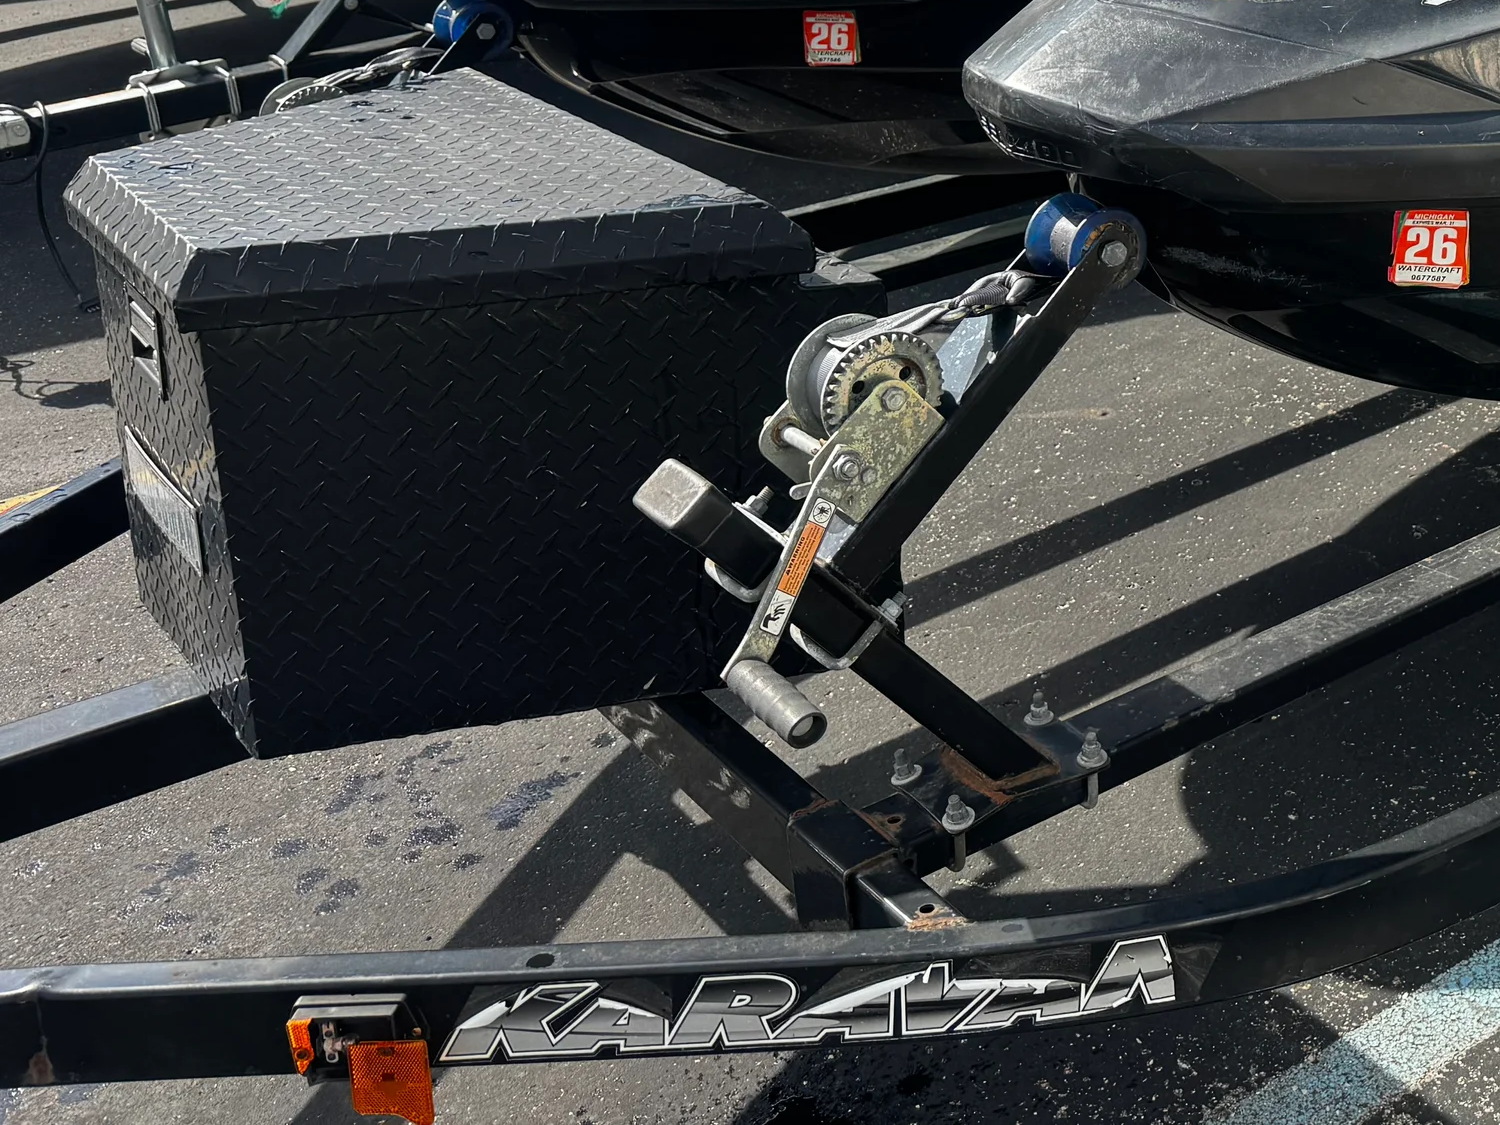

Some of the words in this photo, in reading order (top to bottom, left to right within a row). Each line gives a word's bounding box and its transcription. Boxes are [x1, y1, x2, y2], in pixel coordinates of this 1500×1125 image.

[810, 23, 849, 50] 26
[1404, 227, 1458, 265] 26
[1398, 265, 1461, 274] WATERCRAFT
[788, 537, 805, 569] WARNING
[438, 935, 1176, 1063] KARAVAN
